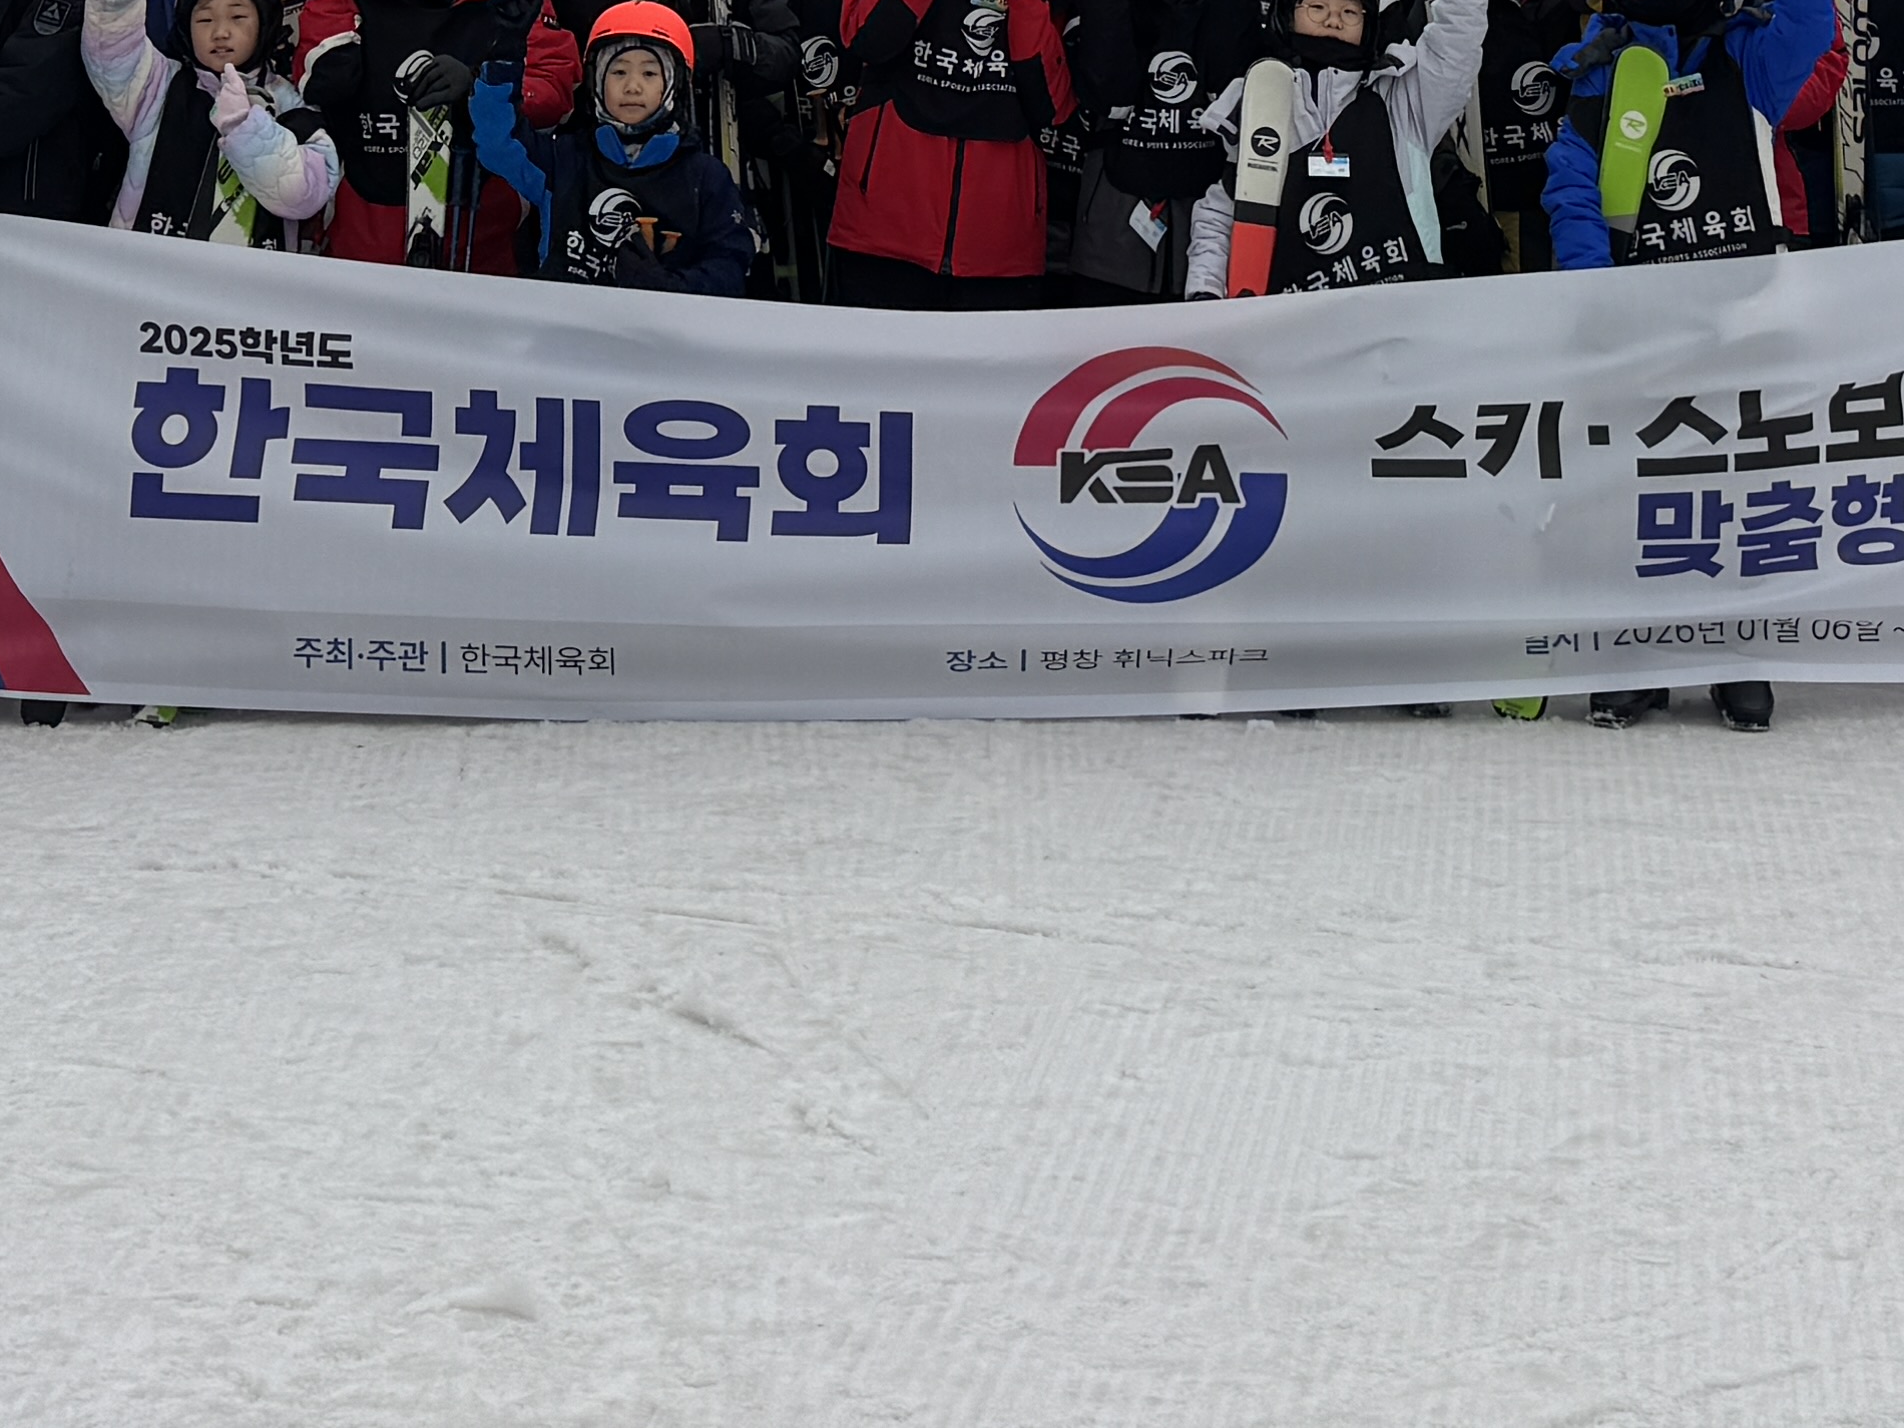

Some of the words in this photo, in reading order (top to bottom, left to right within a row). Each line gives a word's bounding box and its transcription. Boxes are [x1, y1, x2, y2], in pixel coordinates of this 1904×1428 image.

[138, 322, 354, 370] 2025학년도
[130, 366, 914, 544] 한국체육회
[1812, 617, 1881, 643] 06일
[294, 637, 428, 673] 주최·주관
[460, 643, 615, 676] 한국체육회
[946, 648, 1008, 673] 장소
[1041, 648, 1102, 671] 평창
[1113, 647, 1269, 669] 휘닉스파크
